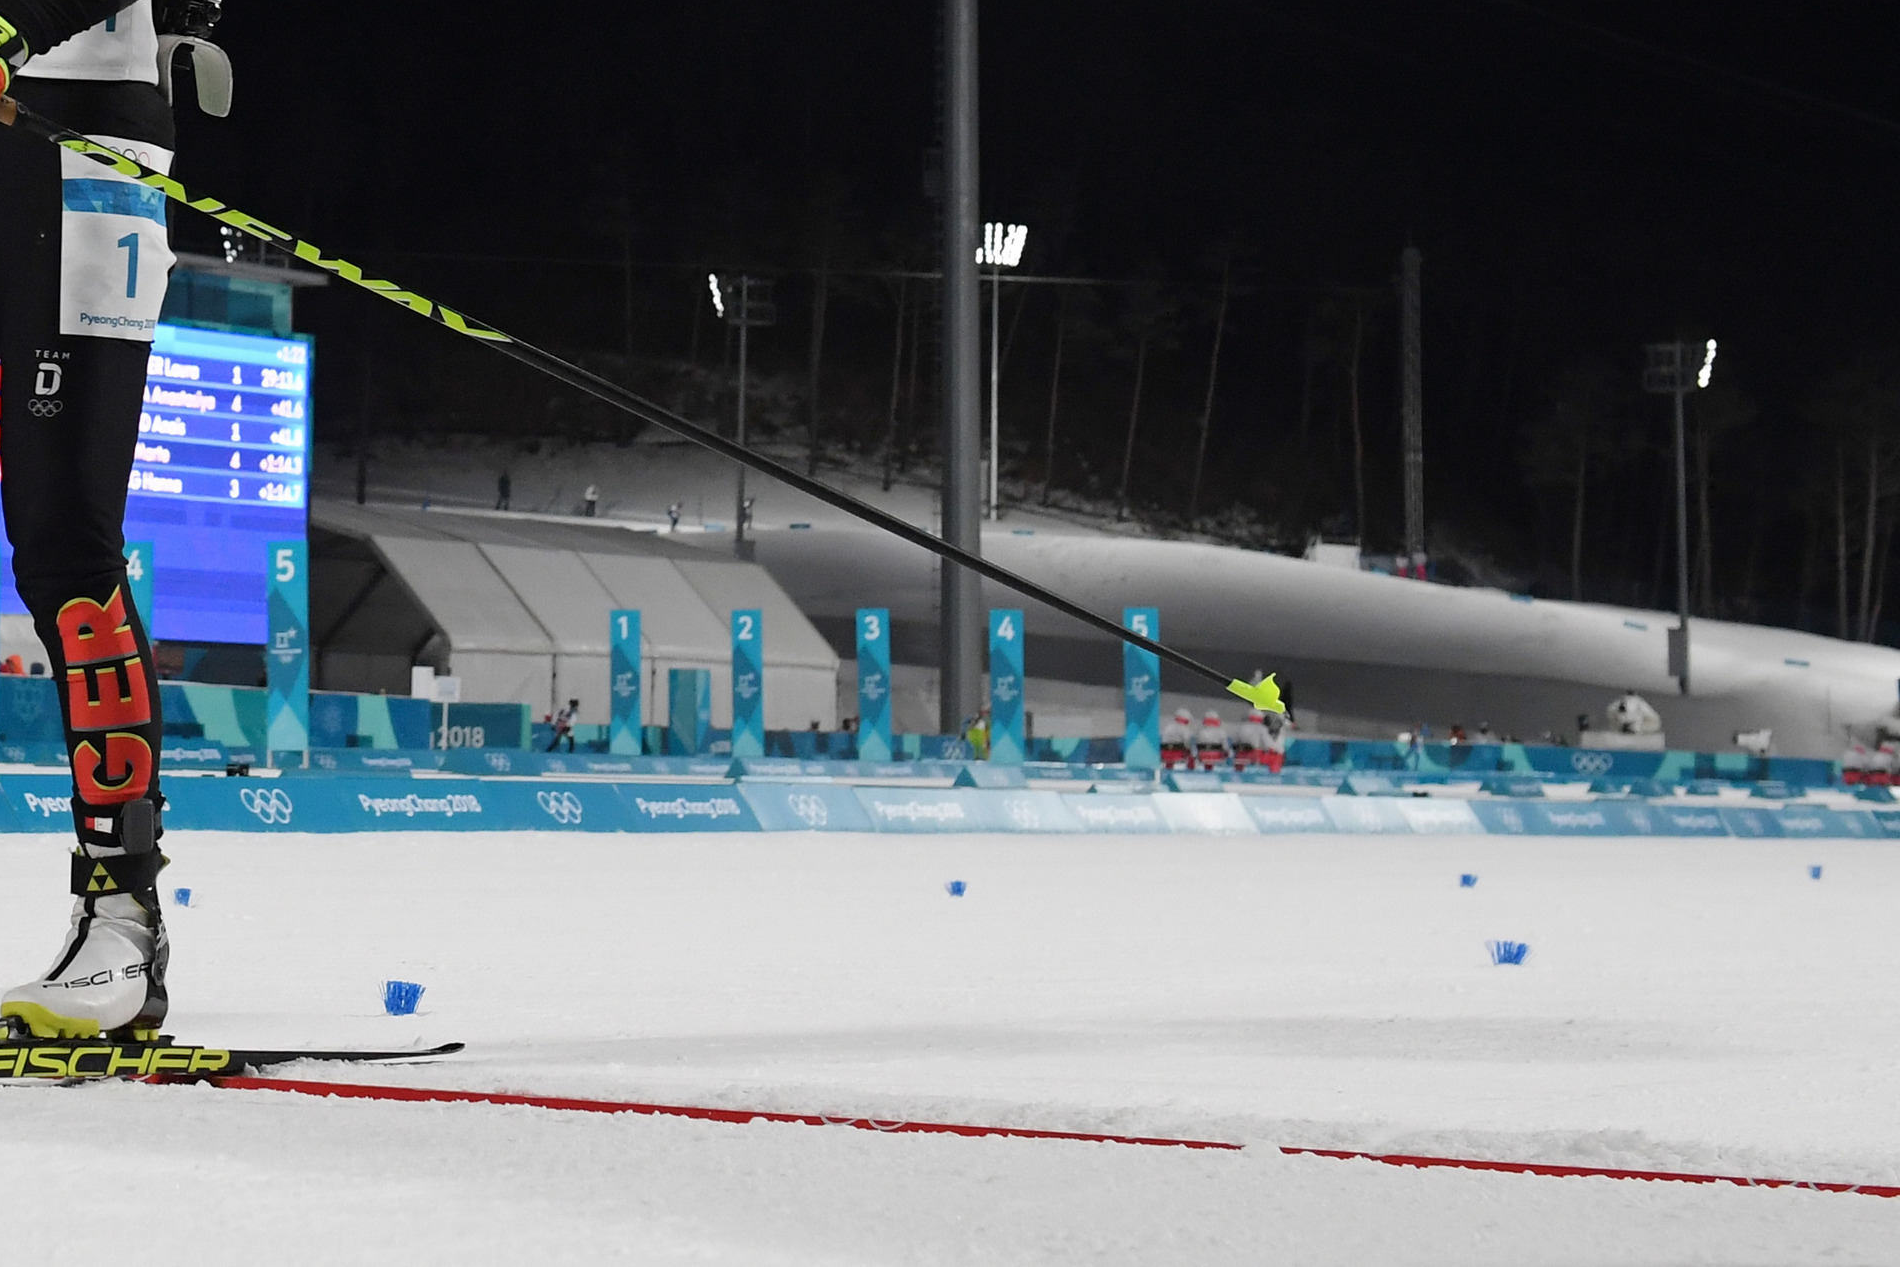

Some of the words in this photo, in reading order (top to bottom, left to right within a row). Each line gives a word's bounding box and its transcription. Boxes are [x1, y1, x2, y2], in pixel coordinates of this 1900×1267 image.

[117, 232, 140, 299] 1
[80, 312, 144, 331] PyeongChang
[35, 349, 71, 360] TEAM
[126, 549, 143, 581] 4
[275, 549, 296, 583] 5
[617, 615, 629, 640] 1
[737, 615, 753, 640] 2
[863, 615, 881, 641] 3
[996, 616, 1016, 641] 4
[1132, 614, 1149, 637] 5
[56, 584, 152, 806] GER
